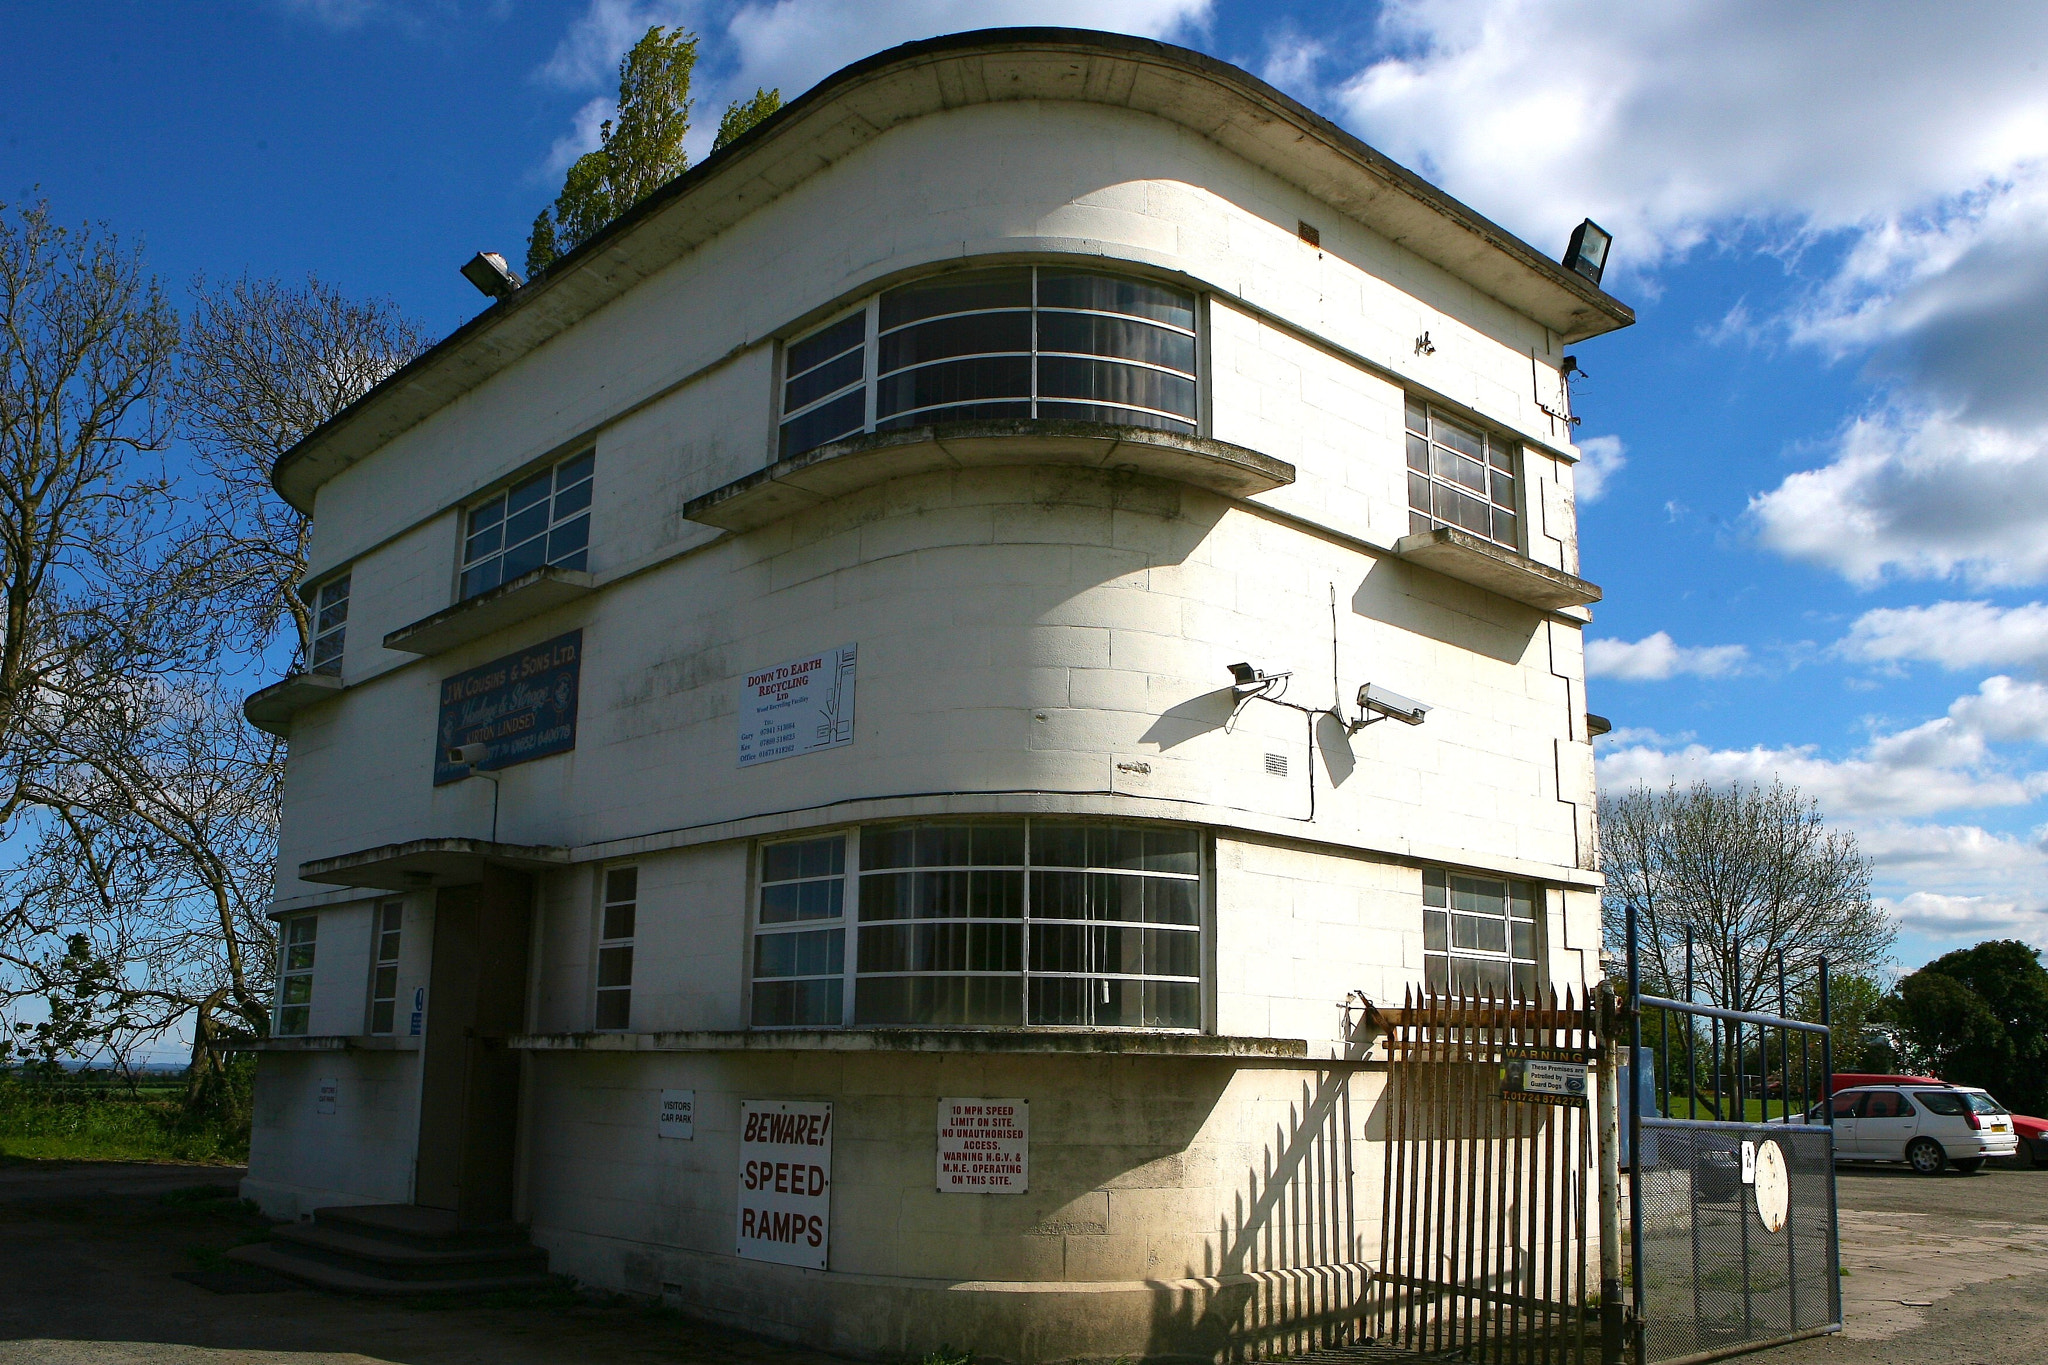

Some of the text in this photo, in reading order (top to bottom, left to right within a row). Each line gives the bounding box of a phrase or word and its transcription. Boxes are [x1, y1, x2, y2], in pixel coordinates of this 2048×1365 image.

[511, 665, 519, 681] &
[522, 653, 549, 675] SONS
[748, 659, 822, 687] DOWN TO EARTH
[759, 676, 809, 697] RECYCLING
[777, 692, 788, 701] LTD
[498, 713, 536, 736] LINDSEY
[740, 754, 756, 762] Office
[1506, 1048, 1583, 1062] WARNING
[1548, 1065, 1573, 1073] Premises
[1555, 1073, 1562, 1081] by
[1548, 1082, 1561, 1090] Dogs
[1542, 1095, 1583, 1106] 874273
[664, 1101, 691, 1111] VISITORS
[952, 1106, 1014, 1115] 10 MPH SPEED
[661, 1113, 692, 1124] CAR PARK
[951, 1118, 1014, 1127] LIMIT ON SITE.
[744, 1112, 830, 1146] BEWARE!
[942, 1129, 1023, 1139] NO UNAUTHORISED
[964, 1141, 1000, 1150] ACCESS.
[944, 1152, 1021, 1162] WARNING H.G.V. &
[943, 1164, 1021, 1173] M.H.E. OPERATING
[745, 1161, 824, 1196] SPEED
[952, 1175, 1012, 1185] ON THIS SITE.
[742, 1207, 823, 1247] RAMPS
